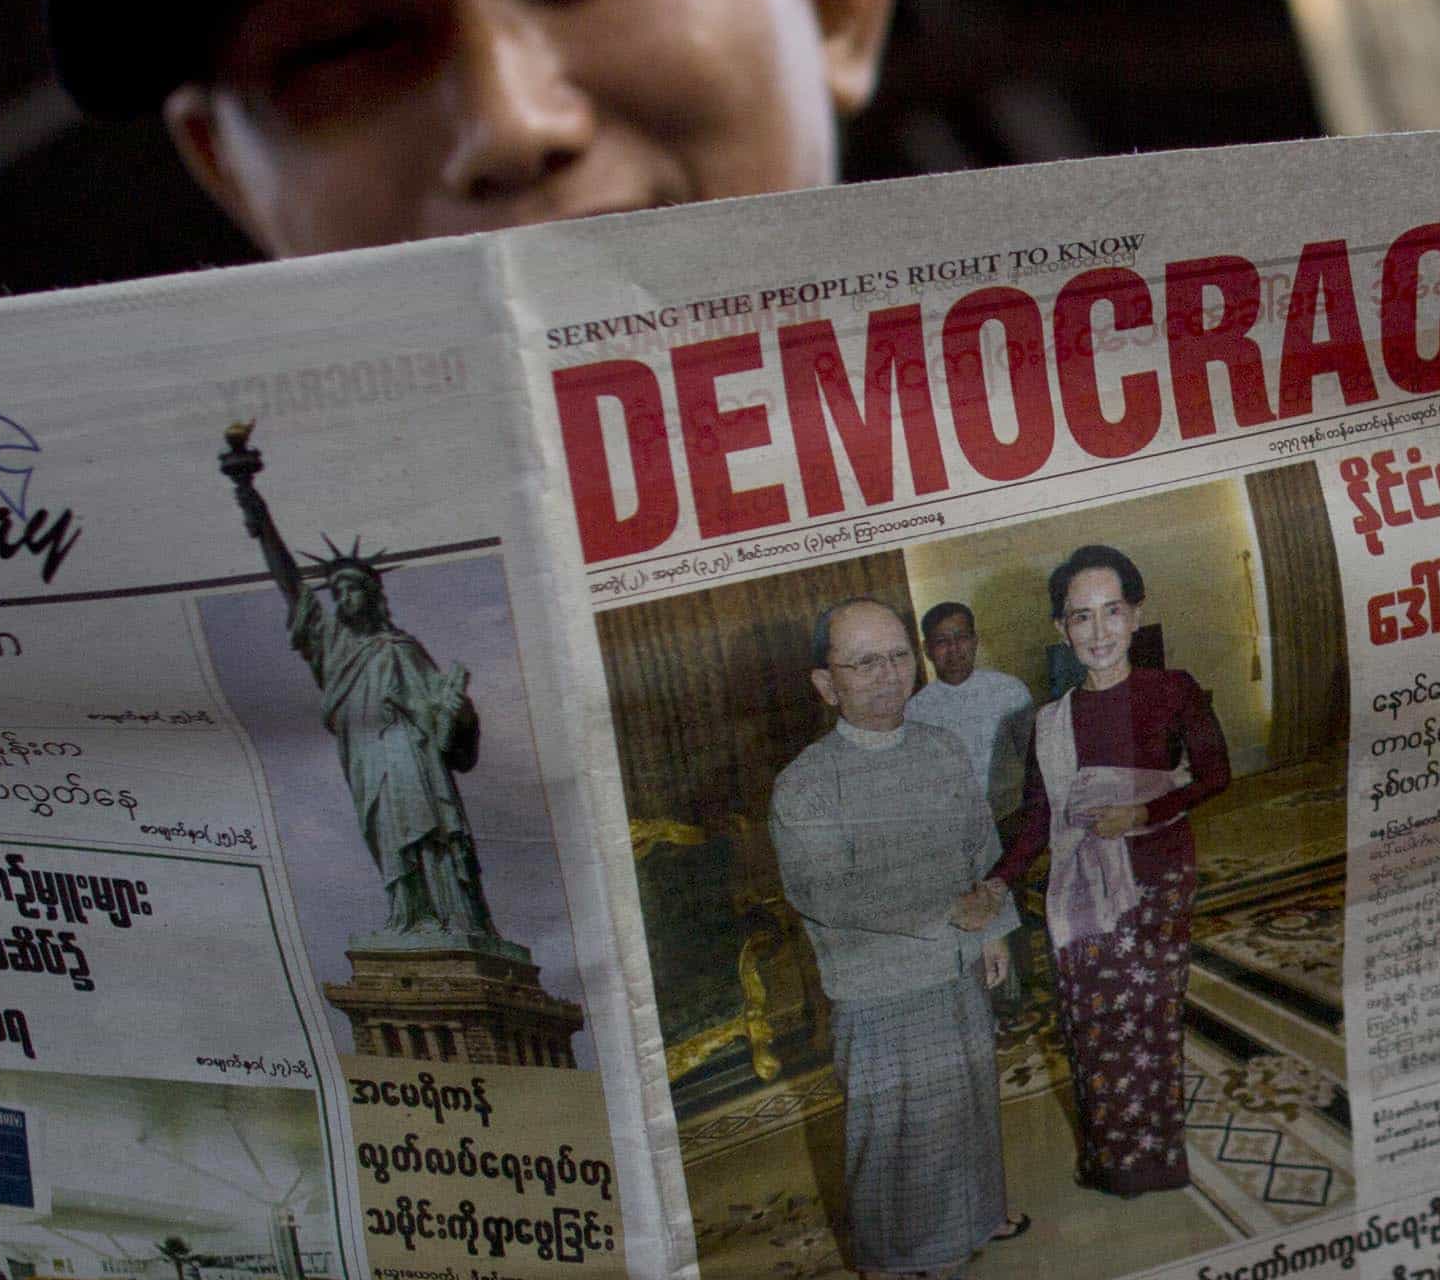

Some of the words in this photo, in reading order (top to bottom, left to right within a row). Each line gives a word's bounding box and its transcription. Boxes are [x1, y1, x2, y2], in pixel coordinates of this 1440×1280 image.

[545, 306, 679, 351] SERVING
[686, 291, 752, 323] THE
[758, 271, 900, 311] PEOPLE'S
[906, 251, 1000, 287] RIGHT
[1010, 247, 1051, 272] TO
[1056, 232, 1145, 263] KNOW
